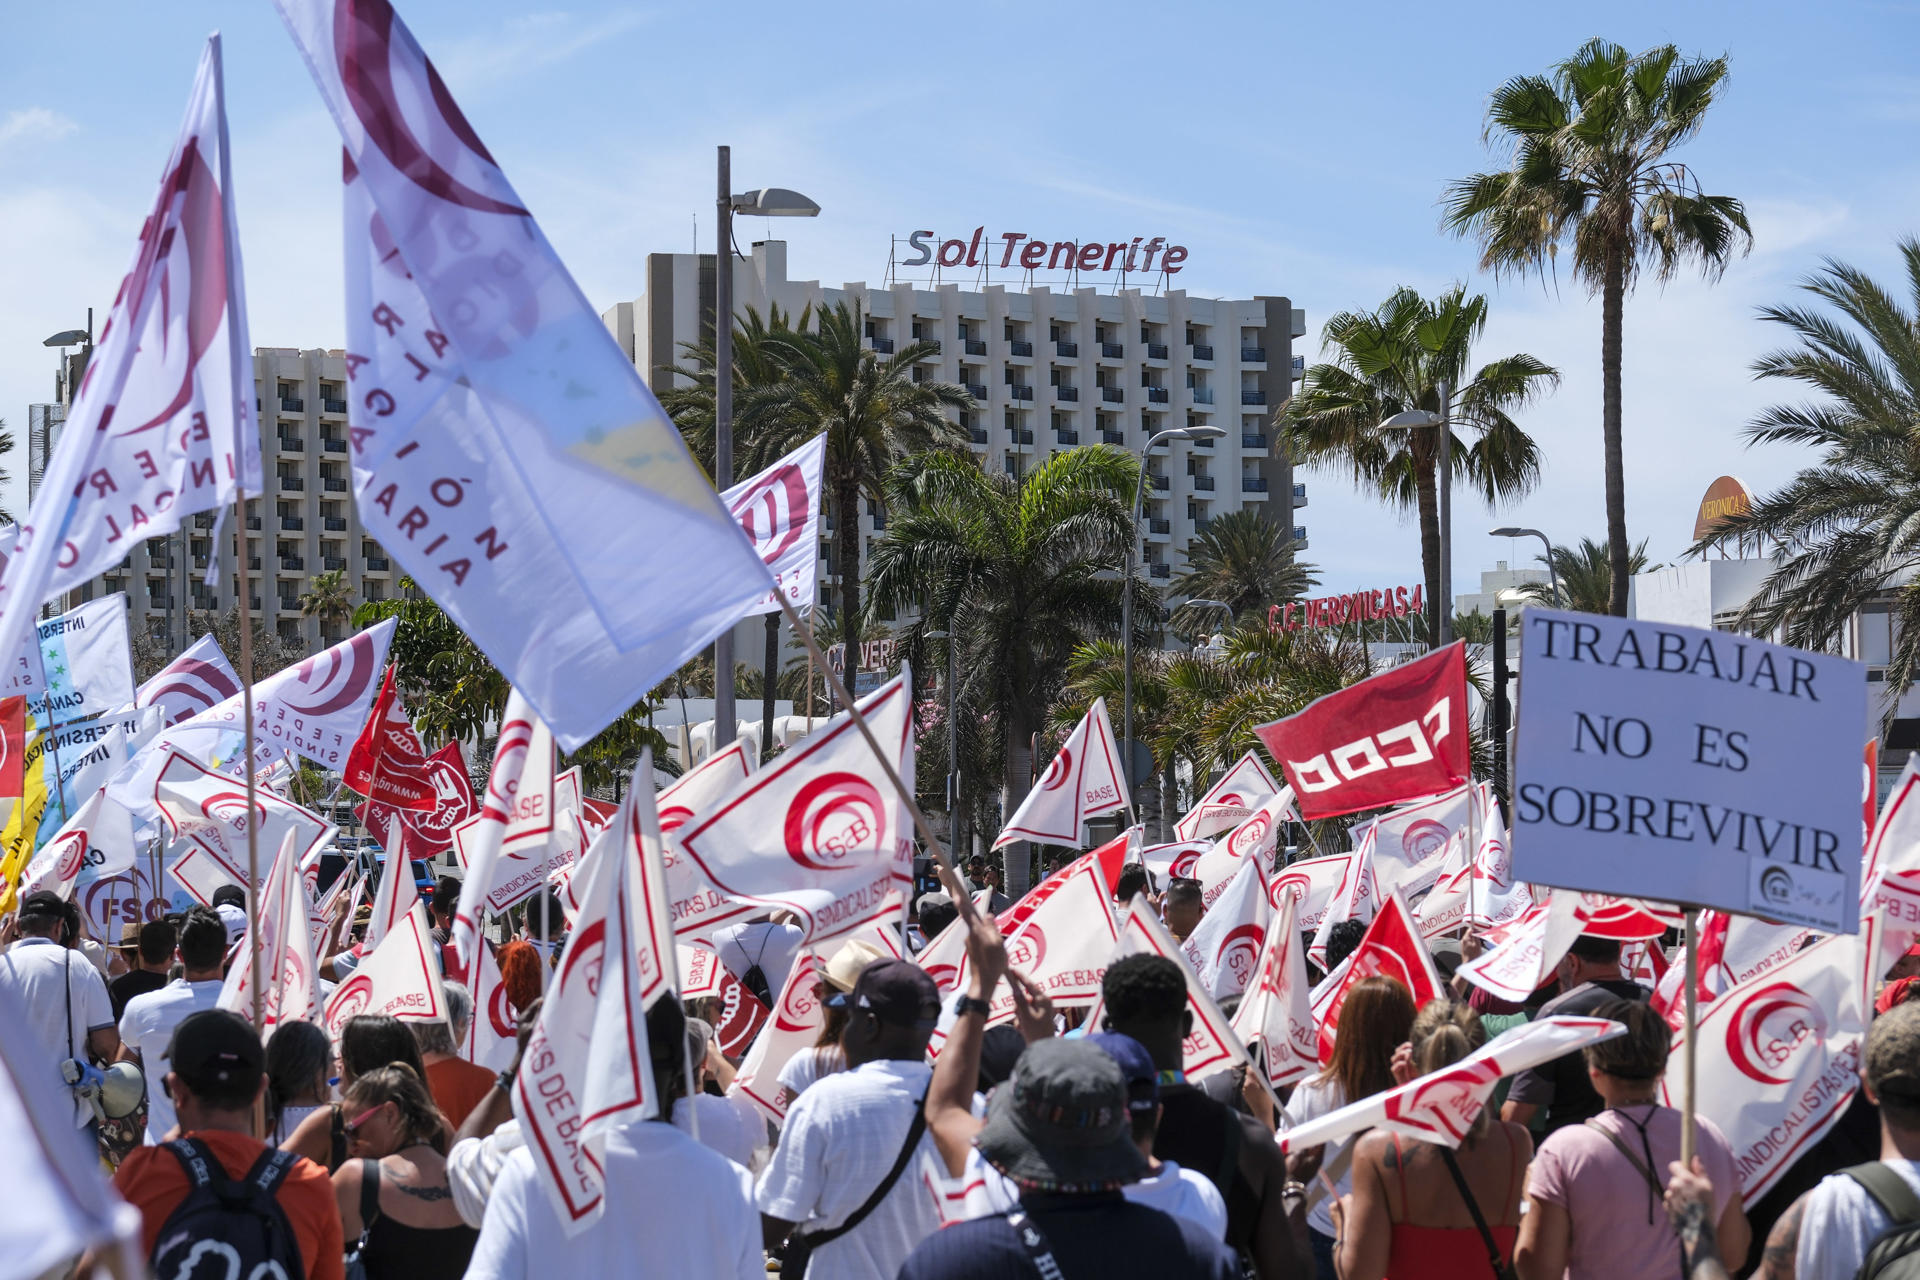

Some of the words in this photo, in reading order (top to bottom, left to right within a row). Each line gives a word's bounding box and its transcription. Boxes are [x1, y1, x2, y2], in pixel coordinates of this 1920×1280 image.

[902, 226, 984, 268] Sol
[1000, 232, 1189, 274] Tenerife
[1702, 495, 1739, 520] VERONICA
[1304, 584, 1408, 628] VERONICAS
[1411, 583, 1424, 615] 4
[1533, 617, 1820, 702] TRABAJAR
[1573, 711, 1652, 759] NO
[1693, 723, 1749, 772] ES
[1086, 784, 1115, 803] BASE
[1518, 783, 1844, 873] SOBREVIVIR
[102, 897, 173, 925] FSC
